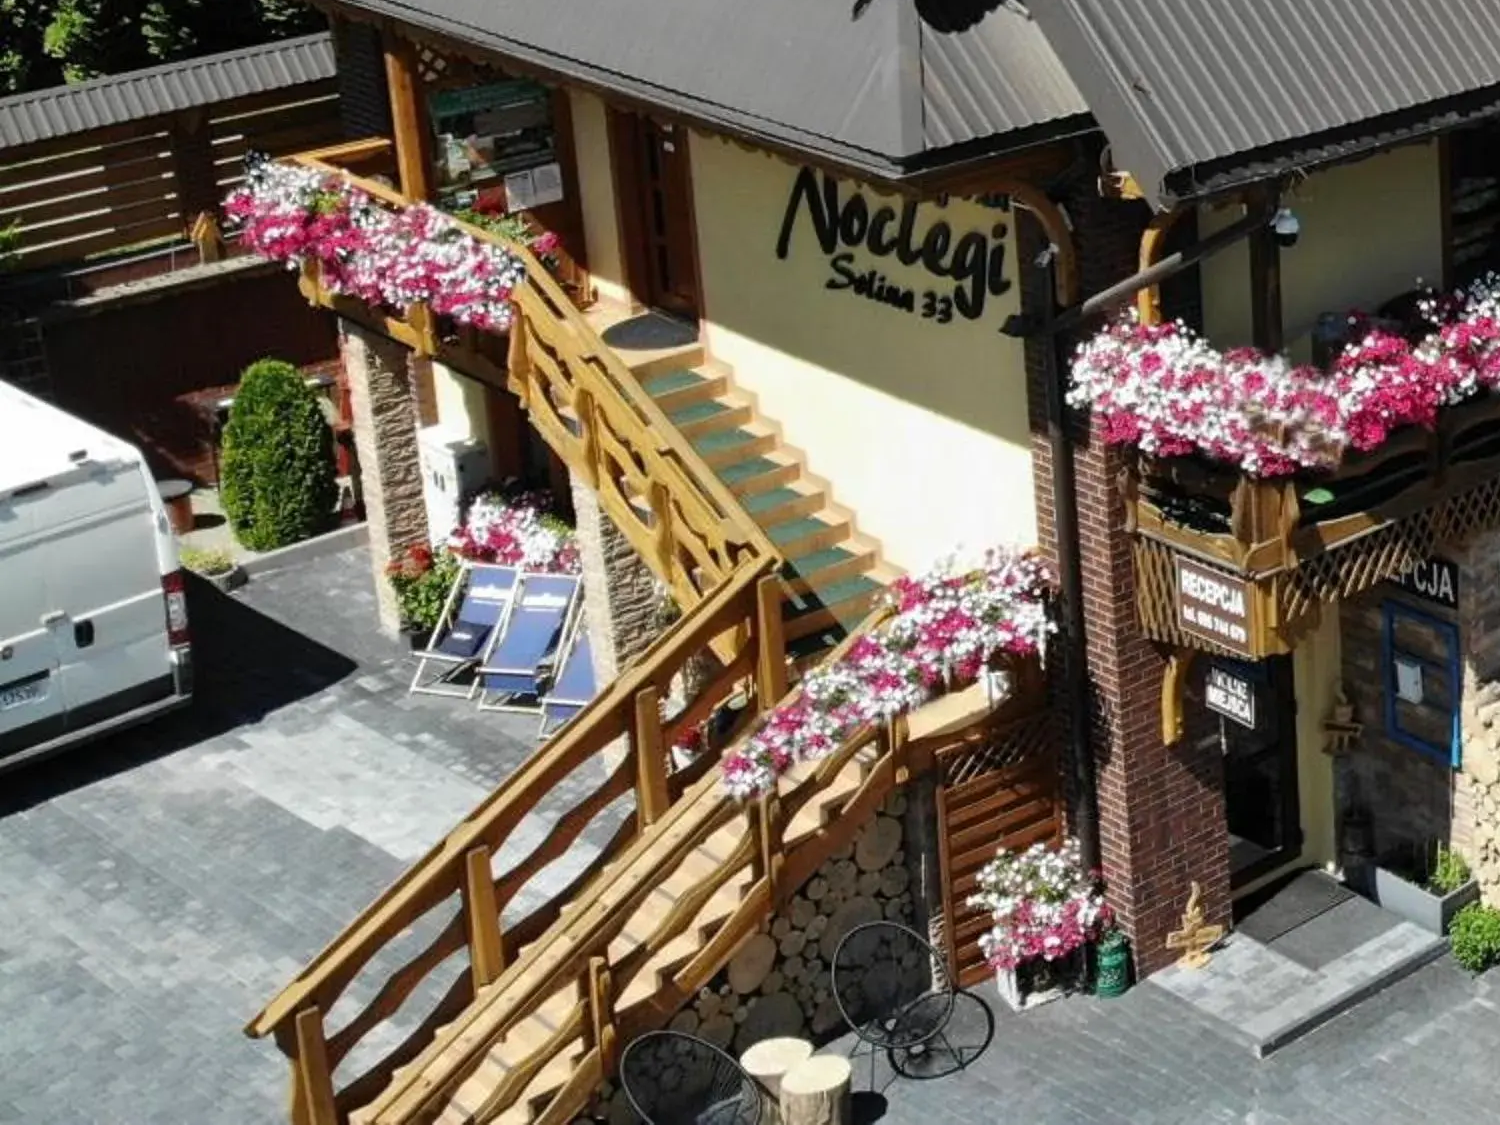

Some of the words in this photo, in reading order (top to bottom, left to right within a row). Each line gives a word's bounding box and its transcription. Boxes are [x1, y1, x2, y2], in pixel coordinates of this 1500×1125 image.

[776, 165, 1012, 320] Noclegi
[825, 252, 915, 313] Solina
[920, 289, 953, 324] 33
[1180, 567, 1246, 619] RECEPCJA
